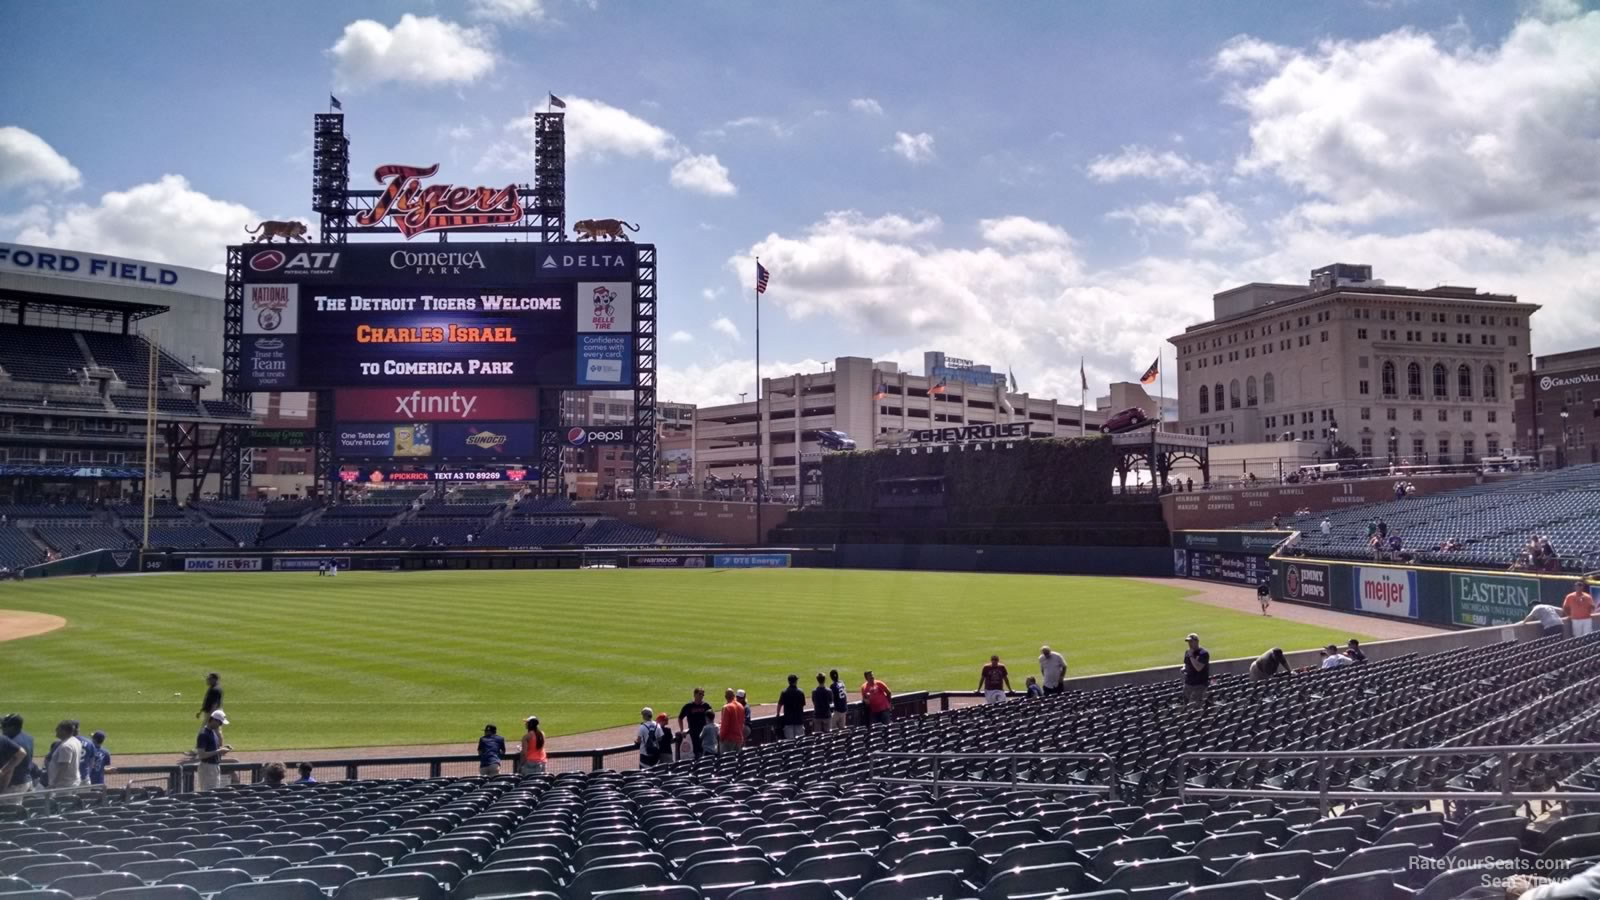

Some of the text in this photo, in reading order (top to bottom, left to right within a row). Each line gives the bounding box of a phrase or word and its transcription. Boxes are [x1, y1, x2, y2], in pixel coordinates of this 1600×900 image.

[355, 162, 524, 240] Tigers
[285, 252, 340, 268] ATI
[562, 255, 625, 267] DELTA
[0, 248, 179, 286] FORD FIELD
[415, 267, 461, 275] PARK
[252, 287, 289, 302] NATIONAL
[592, 316, 615, 324] BELLE
[583, 336, 624, 344] Confidence
[583, 351, 603, 359] every
[251, 357, 286, 370] Team
[252, 370, 265, 378] that
[1552, 377, 1581, 386] GRAND
[395, 390, 477, 418] xfinity
[588, 430, 624, 442] pepsi
[917, 421, 1034, 443] CHEVROLET
[466, 436, 506, 444] SUNOCO
[896, 443, 1014, 456] FOUNTAIN
[389, 472, 428, 480] #PICKRICK
[435, 472, 452, 480] TEXT
[453, 472, 464, 480] A3
[465, 472, 476, 480] TO
[476, 472, 500, 480] 89269
[1343, 484, 1353, 494] 11
[188, 560, 214, 568] DMC
[751, 557, 780, 566] Energy
[1300, 569, 1324, 581] JIMMY
[1301, 583, 1324, 597] JOHN'S
[1364, 575, 1404, 608] meijer
[1460, 576, 1528, 606] EASTERN
[1460, 602, 1490, 612] MICHIGAN
